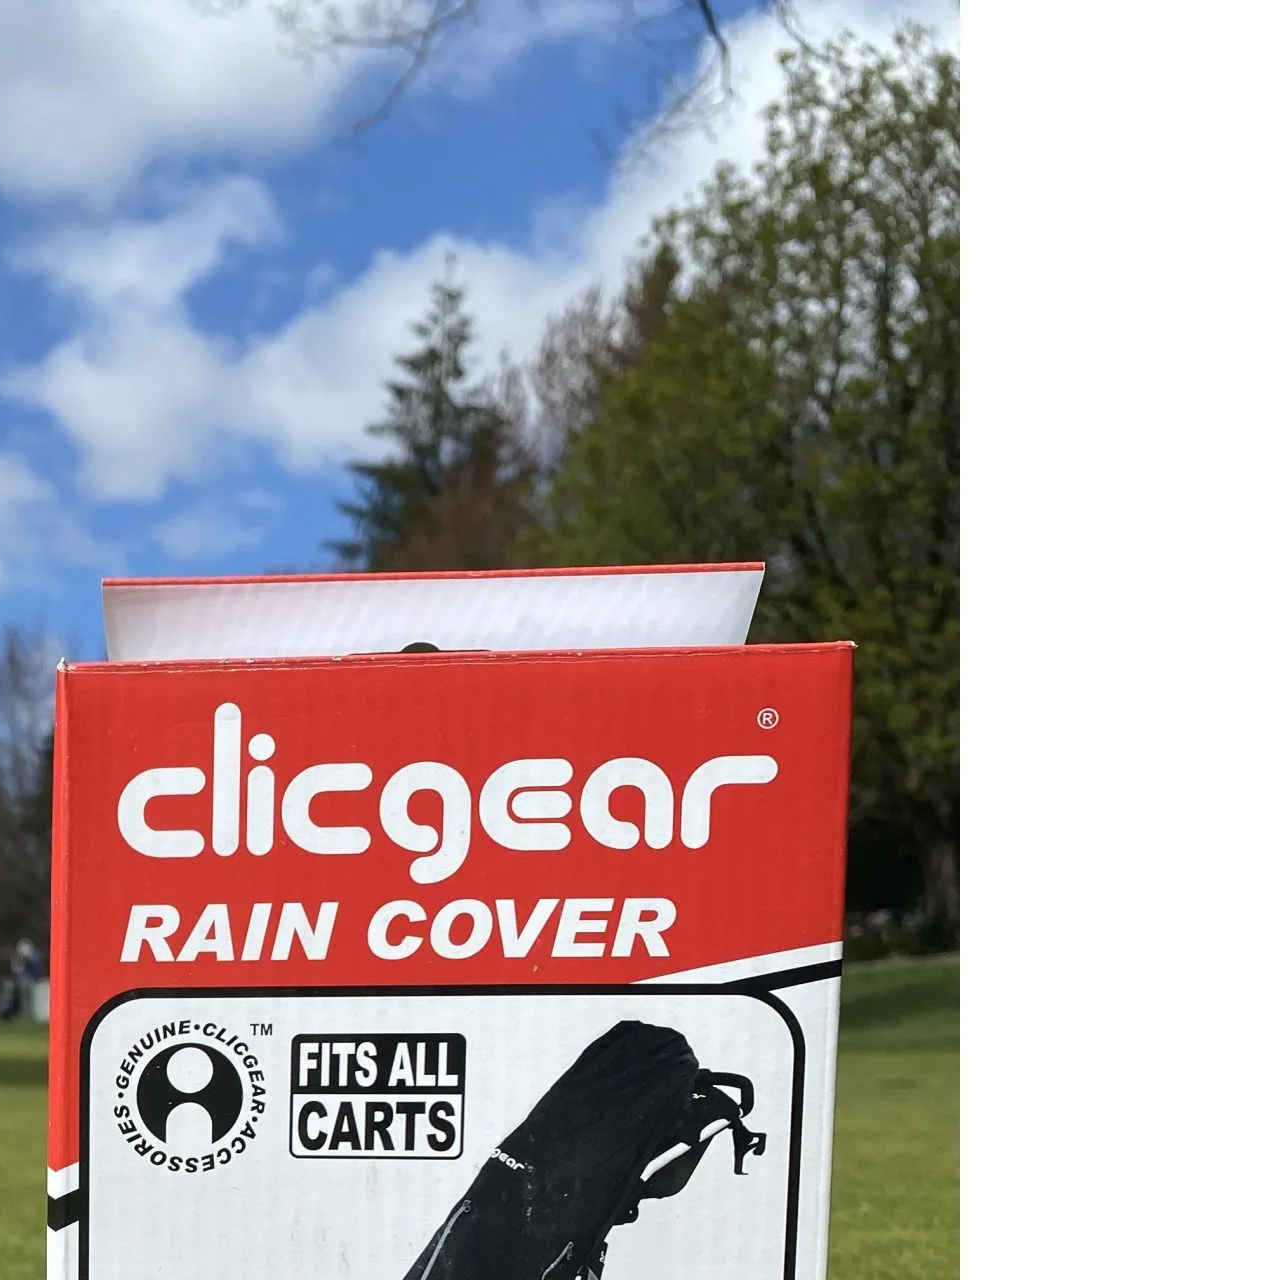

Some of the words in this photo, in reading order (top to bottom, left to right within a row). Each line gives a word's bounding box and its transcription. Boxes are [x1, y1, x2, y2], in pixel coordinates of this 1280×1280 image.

[118, 702, 779, 885] clicgear
[120, 901, 339, 962] RAIN
[367, 897, 677, 961] COVER
[115, 1019, 191, 1090] GENUINE
[202, 1022, 267, 1115] CLICGEAR
[298, 1042, 378, 1088] FITS
[387, 1042, 459, 1087] ALL
[113, 1104, 257, 1174] ACCESSORIES
[297, 1100, 456, 1152] CARTS
